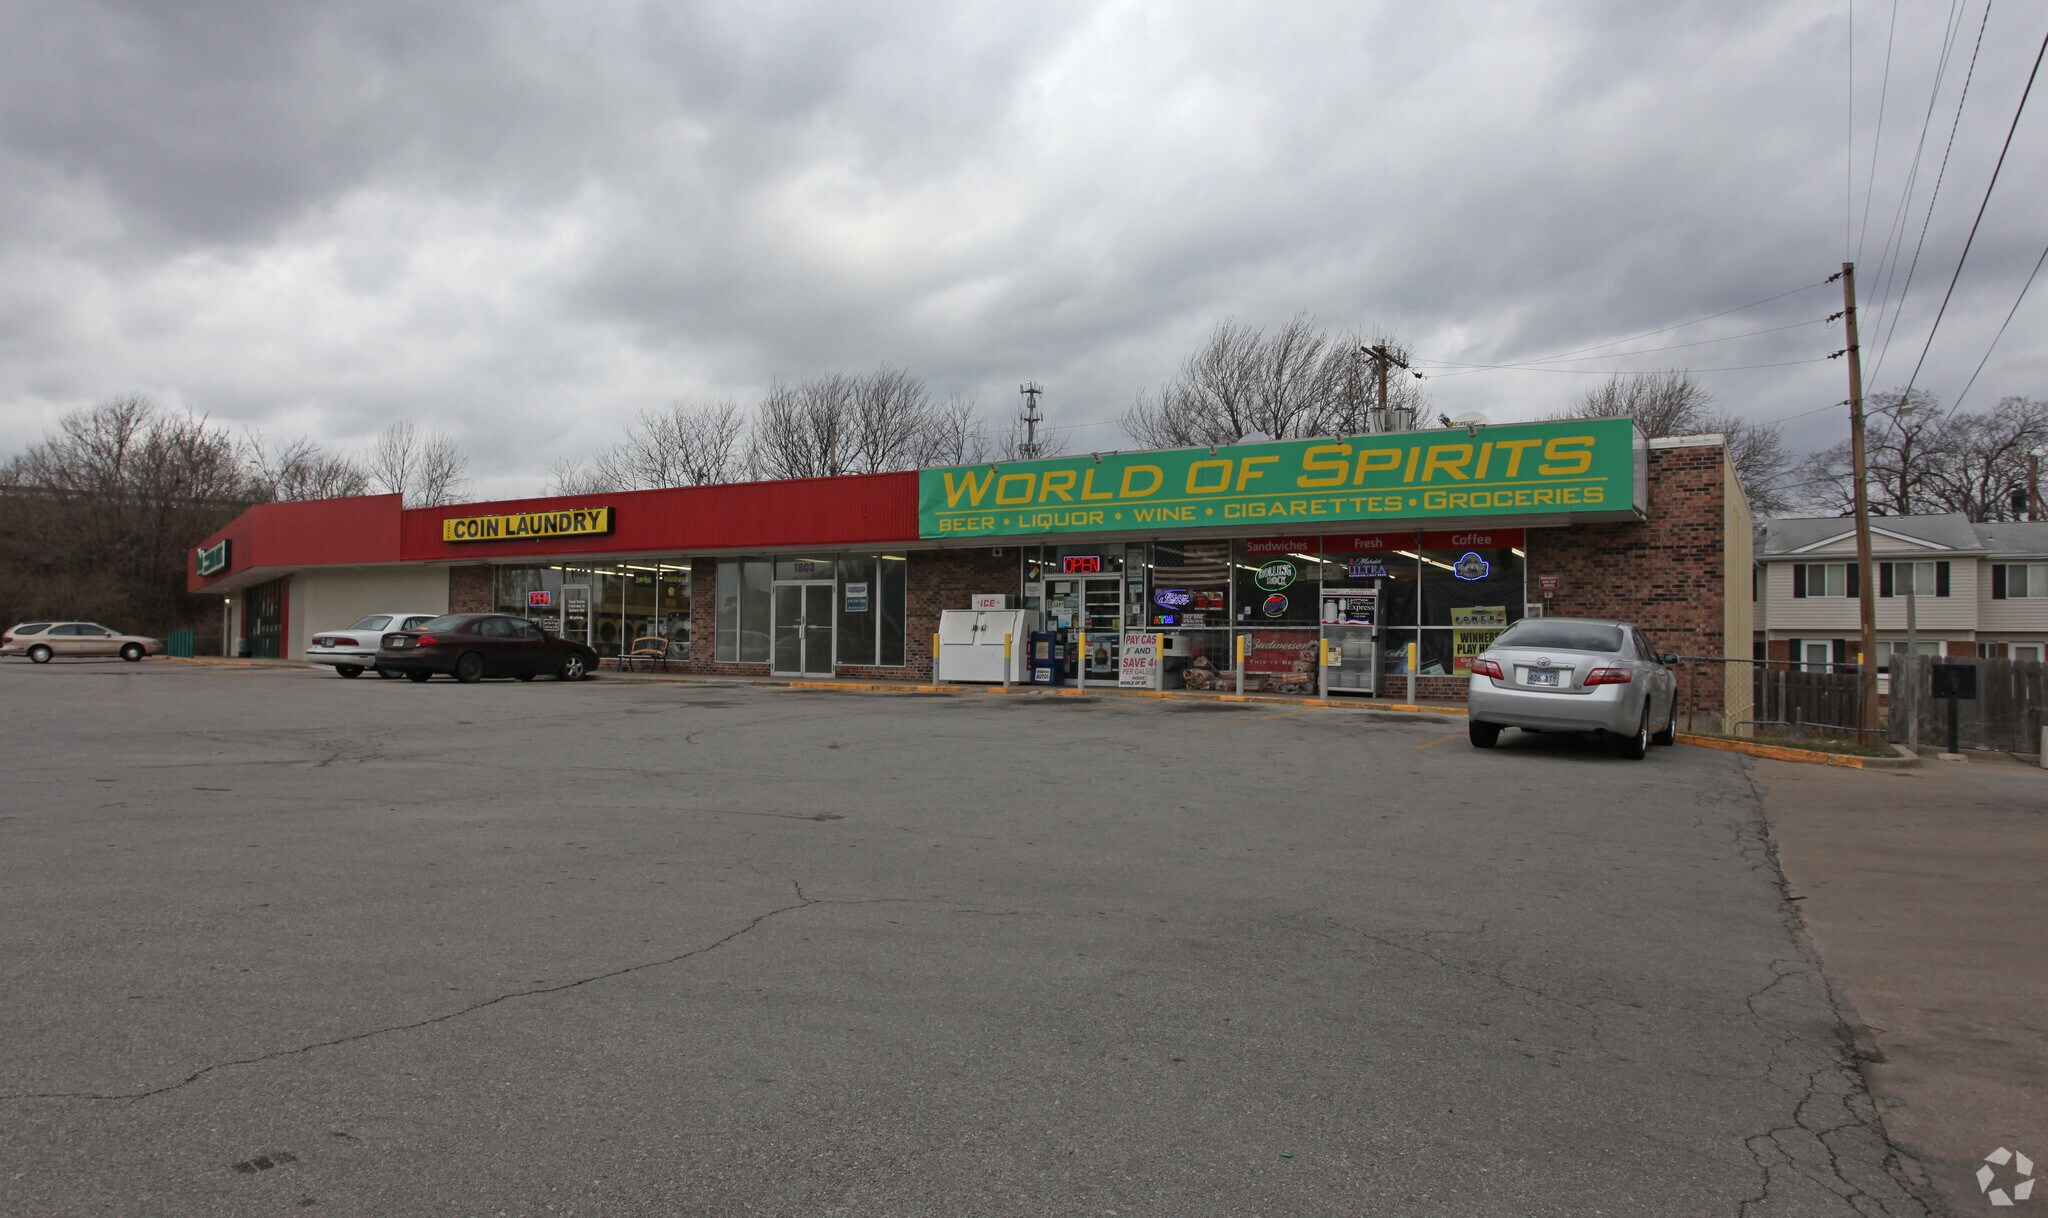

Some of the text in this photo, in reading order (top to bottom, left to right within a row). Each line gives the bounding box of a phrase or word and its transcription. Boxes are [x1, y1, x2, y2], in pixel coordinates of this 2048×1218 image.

[943, 435, 1596, 508] WORLD OF SPIRITS
[939, 486, 1604, 532] BEER LIQUOR WINE CIGARETTES GROCERIES
[454, 518, 499, 538] COIN
[505, 511, 601, 536] LAUNDRY
[1354, 537, 1383, 548] Fresh
[1452, 535, 1492, 545] Coffee
[1247, 541, 1308, 551] Sandwiches
[794, 562, 815, 573] 1802
[1065, 557, 1099, 573] OPEN
[1348, 565, 1387, 574] ULTRA
[1258, 563, 1292, 579] ROLLING
[1266, 576, 1287, 586] ROCK
[530, 593, 550, 605] OPEN
[980, 599, 996, 607] ICE
[1125, 635, 1157, 645] PAY CAS
[1460, 632, 1501, 643] WINNERS
[1252, 639, 1306, 650] Budweiser
[1457, 643, 1479, 654] PLAY
[1123, 657, 1146, 667] SAVE
